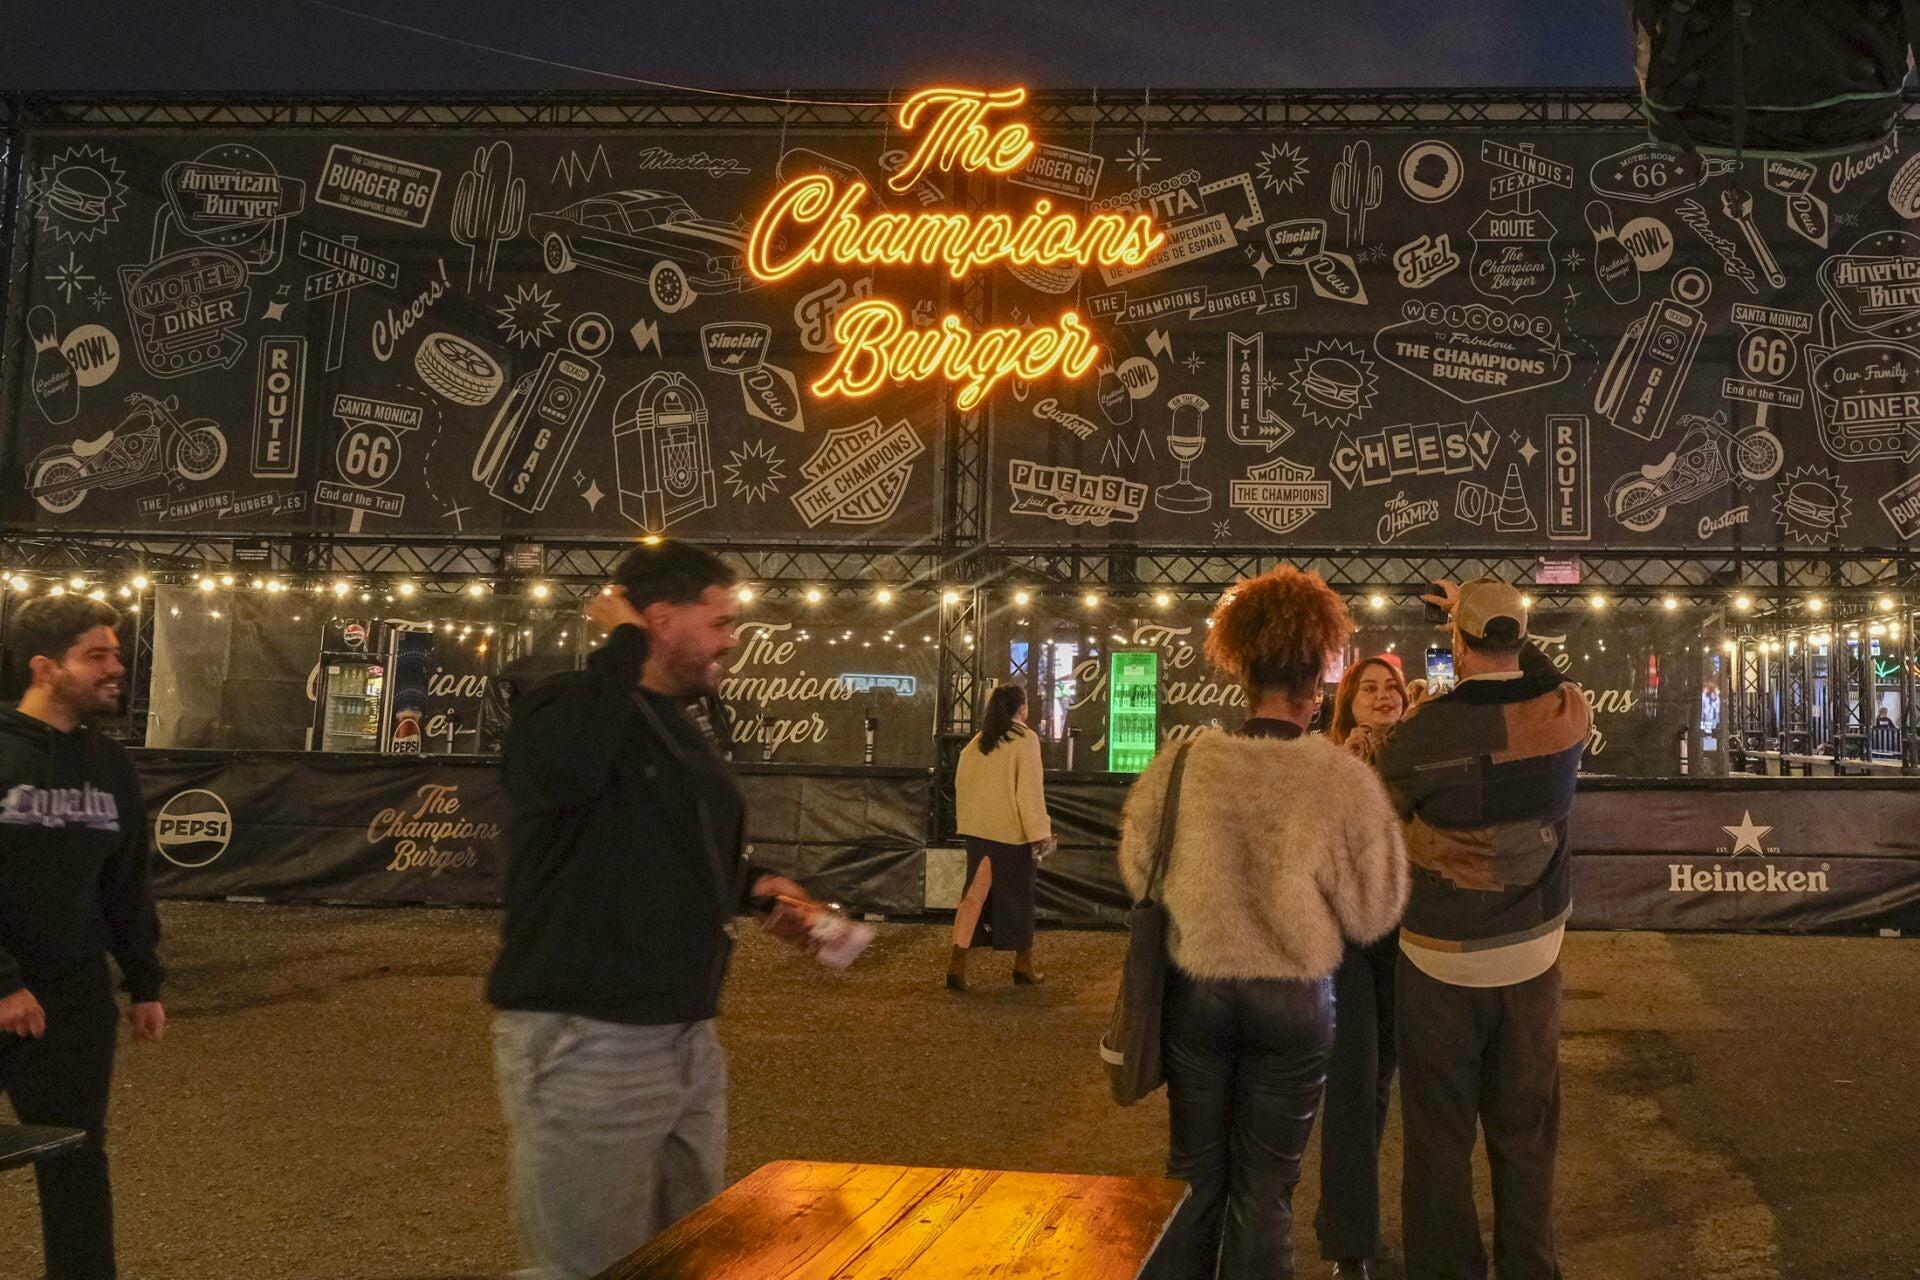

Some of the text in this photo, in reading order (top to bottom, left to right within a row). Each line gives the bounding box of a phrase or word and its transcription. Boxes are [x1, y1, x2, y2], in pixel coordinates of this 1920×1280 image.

[898, 88, 1035, 191] The
[363, 156, 397, 174] CHAMPIONS
[397, 165, 421, 180] BURGER
[639, 147, 750, 178] Mustang
[1026, 156, 1096, 187] URGER 66
[1497, 149, 1562, 182] ILLINOIS
[1620, 152, 1676, 167] MOTEL ROOM
[1769, 161, 1811, 182] Sinclair
[1828, 131, 1900, 193] Cheers!
[182, 170, 280, 193] American
[327, 163, 429, 208] BURGER 66
[1632, 163, 1667, 188] 66
[206, 193, 278, 219] Burger
[748, 175, 1164, 281] Champions
[1166, 219, 1222, 245] AMPEONATO
[1274, 227, 1322, 246] Sinclair
[1490, 219, 1536, 237] ROUTE
[317, 241, 386, 280] ILLINOIS
[1172, 246, 1186, 259] DE
[1190, 232, 1226, 251] ESPAÑA
[1400, 237, 1457, 284] Fuel
[1501, 246, 1525, 264] The
[1313, 257, 1350, 296] Deus
[1478, 258, 1546, 278] Champions
[1490, 274, 1537, 292] Burger
[1837, 258, 1920, 284] Americ
[138, 262, 236, 309] MOTEL
[164, 300, 236, 334] DINER
[372, 258, 451, 362] Cheers!
[1094, 290, 1291, 318] THE CHAMPIONS BURGER .ES
[1406, 303, 1546, 333] WELCOME
[1735, 307, 1808, 330] SANTA MONICA
[709, 331, 764, 350] Sinclair
[811, 300, 1099, 411] Burger
[1434, 331, 1517, 351] TO Fabulous
[1747, 335, 1787, 376] 66
[1396, 342, 1545, 375] THE CHAMPIONS
[1833, 362, 1909, 384] Our Family
[1432, 363, 1508, 386] BURGER
[266, 348, 289, 462] ROUTE
[748, 370, 787, 417] Deus
[1240, 350, 1251, 436] TASTE IT
[1632, 366, 1663, 425] GAS
[1726, 383, 1800, 404] End of the Trail
[1842, 395, 1920, 420] DINER
[338, 399, 417, 425] SANTA MONICA
[1033, 397, 1098, 441] Custom
[345, 432, 392, 479] 66
[513, 427, 552, 496] GAS
[816, 430, 873, 475] MOTOR
[1336, 430, 1492, 472] CHEESY
[804, 434, 911, 513] THE CHAMPIONS
[1016, 465, 1140, 506] PLEASE
[1258, 465, 1305, 482] MOTOR
[1555, 425, 1578, 526] ROUTE
[143, 498, 162, 512] THE
[170, 495, 229, 517] CHAMPIONS
[233, 494, 274, 514] BURGER
[320, 487, 399, 511] End of the Trail
[842, 471, 900, 516] CYCLES
[1238, 487, 1324, 501] THE CHAMPIONS
[1384, 490, 1409, 513] The
[1020, 495, 1116, 524] just Enjoy
[1256, 507, 1304, 527] CYCLES
[1697, 505, 1749, 540] Custom
[728, 621, 797, 675] The
[718, 670, 859, 708] ampions
[411, 783, 461, 820] The
[159, 818, 227, 839] PEPSI
[366, 807, 502, 844] Champions
[386, 839, 480, 878] Burger
